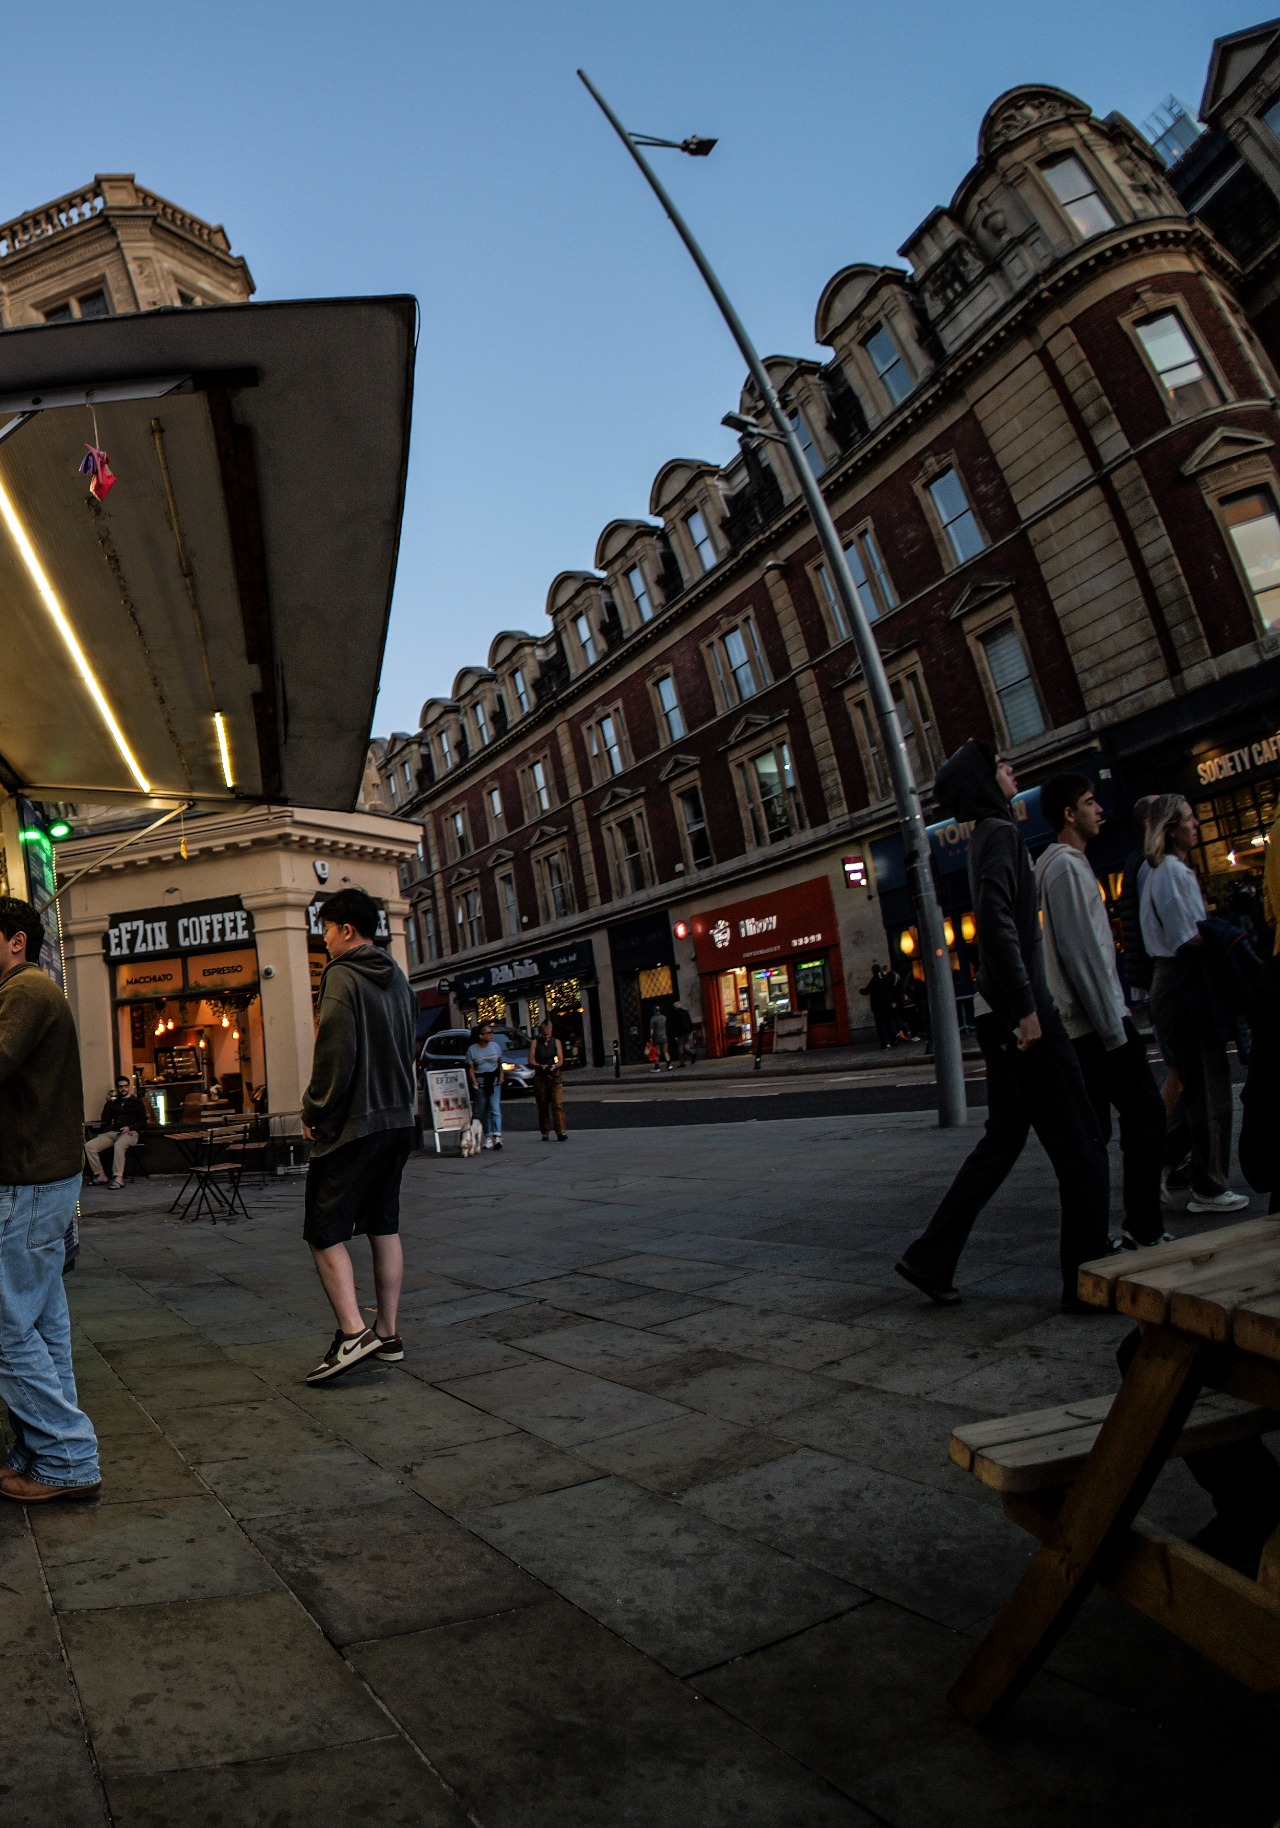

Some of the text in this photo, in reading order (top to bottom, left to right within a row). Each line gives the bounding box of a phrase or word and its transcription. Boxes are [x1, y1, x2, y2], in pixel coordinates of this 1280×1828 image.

[1197, 746, 1251, 785] SOCIETY
[108, 910, 248, 956] EFZIN COFFEE
[126, 974, 173, 985] MACCHIATO
[202, 964, 242, 976] ESPRESSO
